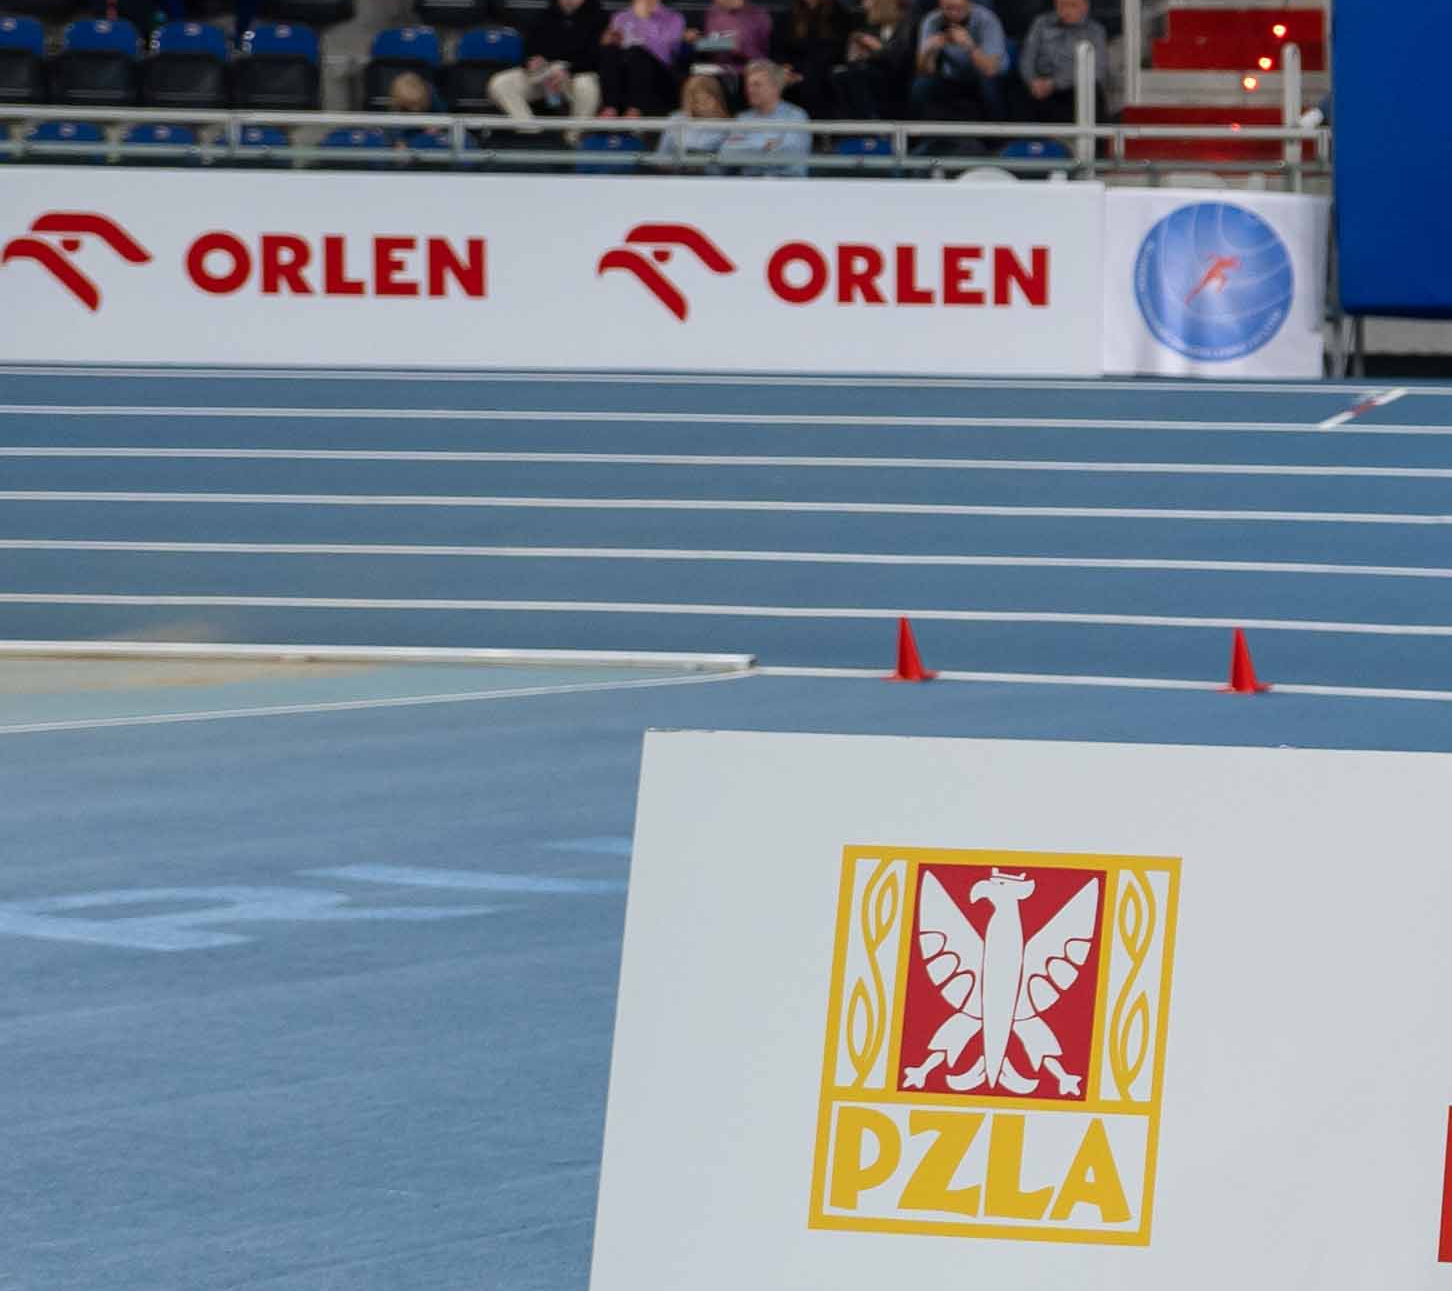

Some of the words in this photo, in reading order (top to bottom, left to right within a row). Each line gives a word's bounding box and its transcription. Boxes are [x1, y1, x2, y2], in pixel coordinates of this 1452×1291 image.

[186, 233, 488, 297] ORLEN
[767, 242, 1050, 308] ORLEN
[829, 1108, 1132, 1226] PZLA
